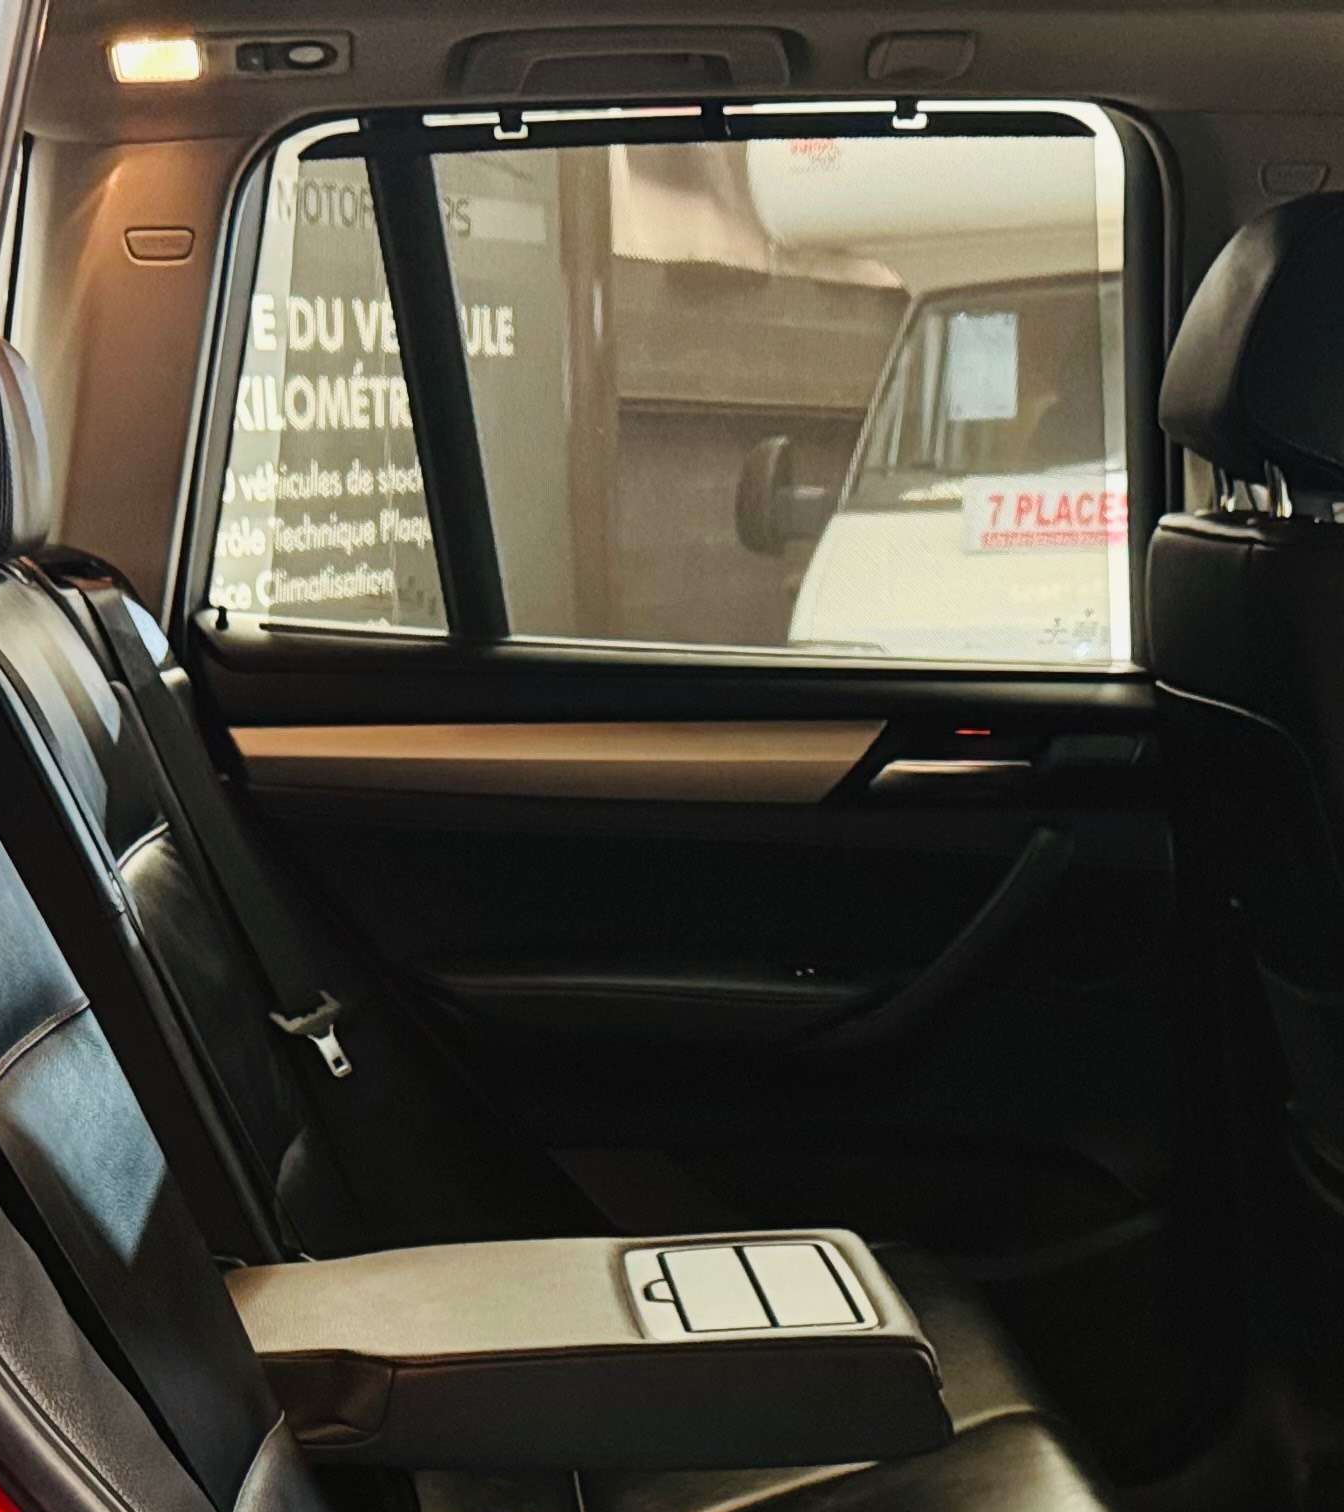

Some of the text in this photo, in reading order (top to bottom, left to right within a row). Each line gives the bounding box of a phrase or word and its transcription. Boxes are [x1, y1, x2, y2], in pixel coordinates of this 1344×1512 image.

[287, 296, 344, 353] DU
[352, 289, 514, 356] VÉULE
[233, 360, 413, 431] KILOMÉTR
[239, 458, 343, 501] véhicules
[346, 458, 374, 496] de
[987, 494, 1005, 526] 7
[217, 517, 266, 558] rôle
[269, 511, 376, 555] Technique
